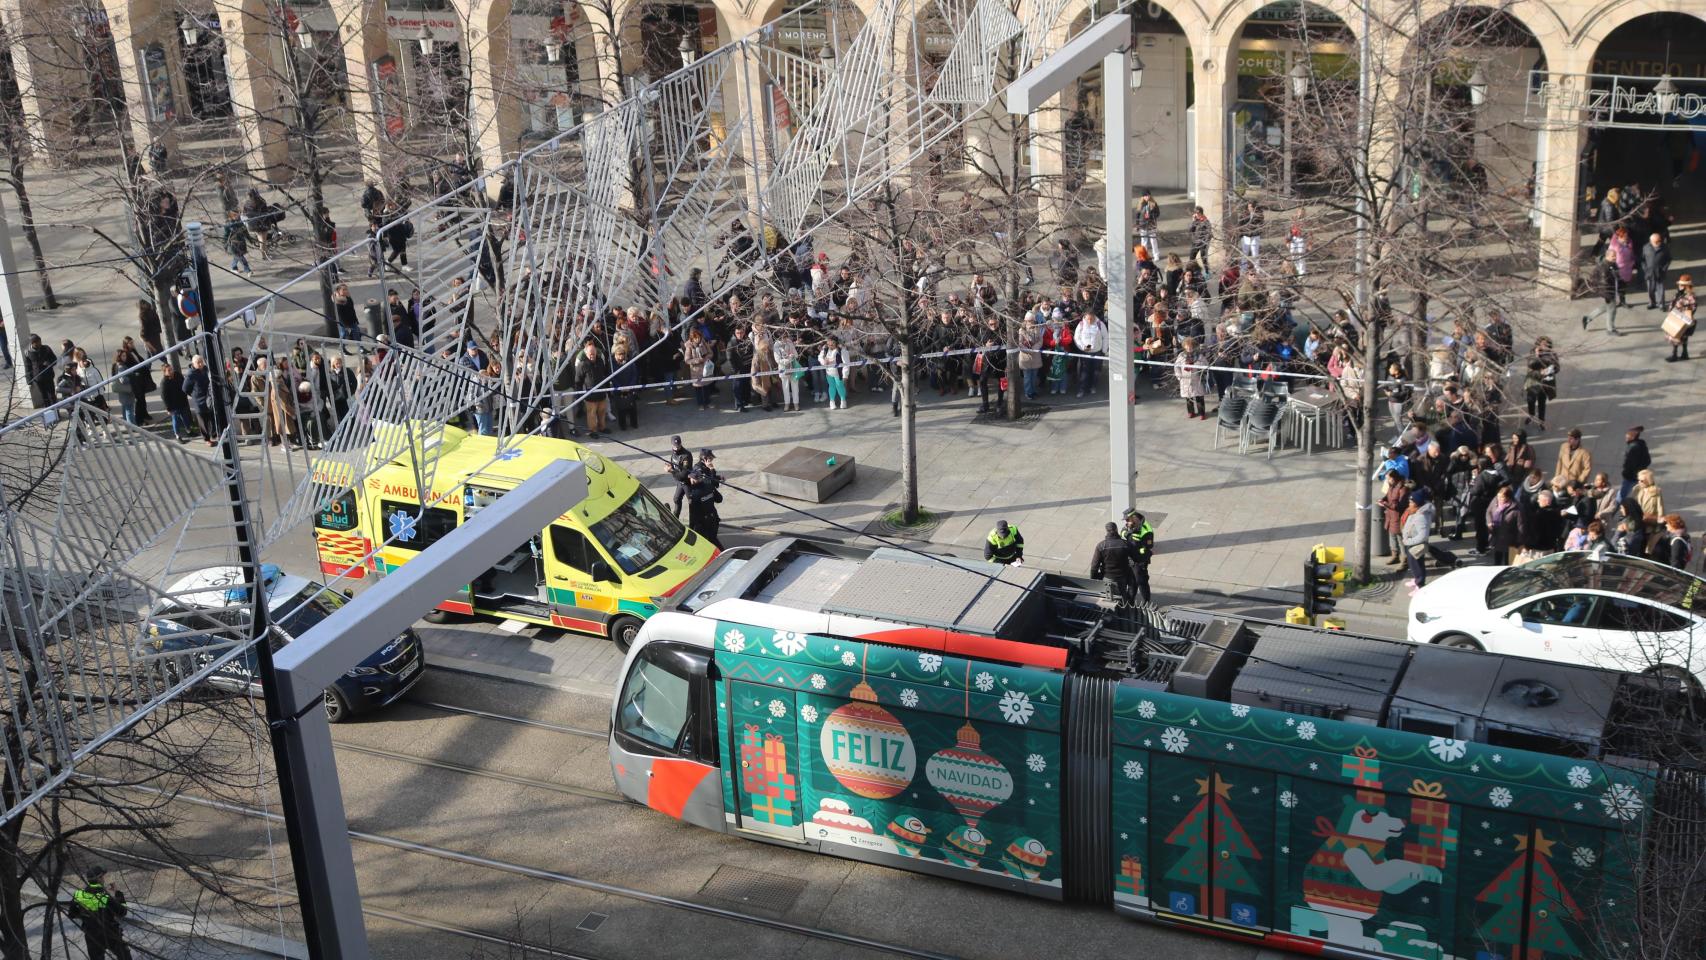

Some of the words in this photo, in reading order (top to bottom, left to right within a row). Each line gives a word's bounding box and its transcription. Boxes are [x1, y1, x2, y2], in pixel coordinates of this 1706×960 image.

[785, 31, 826, 40] MORENO
[383, 484, 461, 506] AMBUANCIA
[321, 513, 348, 525] salud
[832, 729, 906, 772] FELIZ
[936, 766, 1002, 790] NAVIDAD
